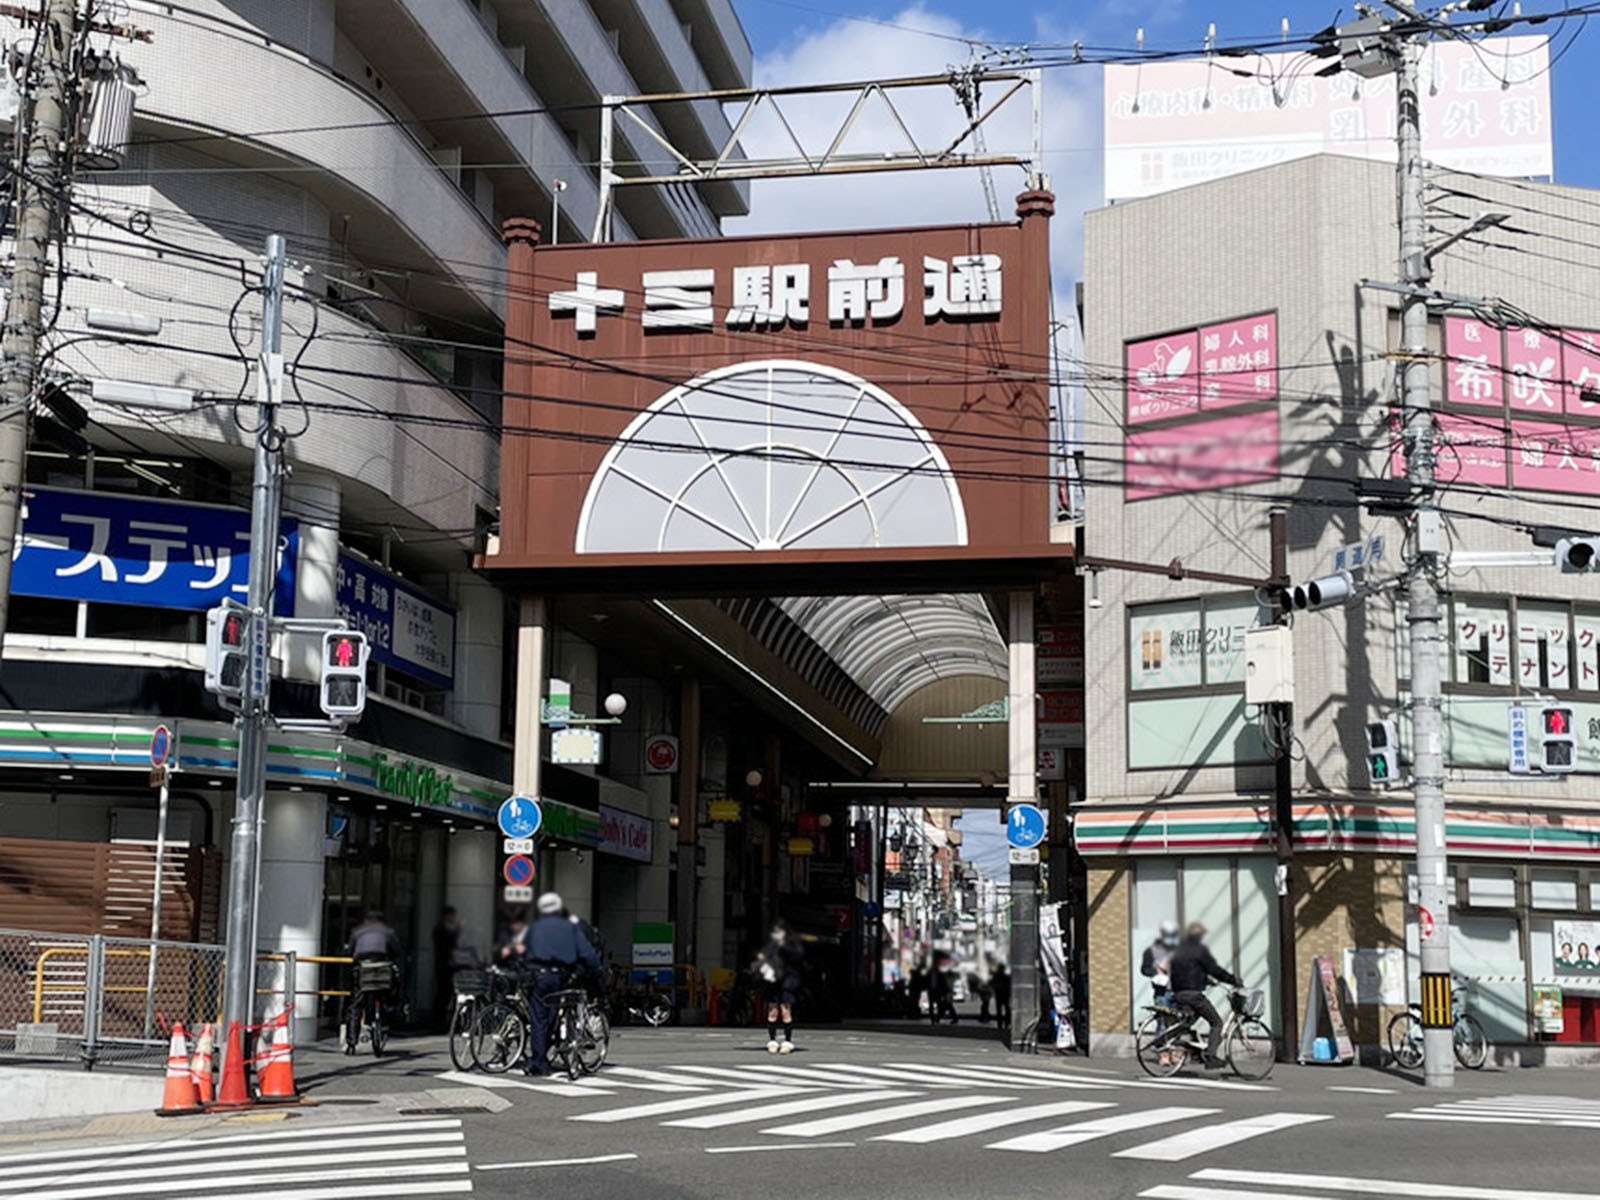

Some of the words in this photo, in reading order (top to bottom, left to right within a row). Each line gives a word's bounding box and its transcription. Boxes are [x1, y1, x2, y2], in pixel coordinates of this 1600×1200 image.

[548, 253, 1003, 334] 十三駅前通
[1204, 323, 1268, 352] 婦人科
[1462, 621, 1593, 649] クリニック
[1492, 656, 1594, 680] テナント
